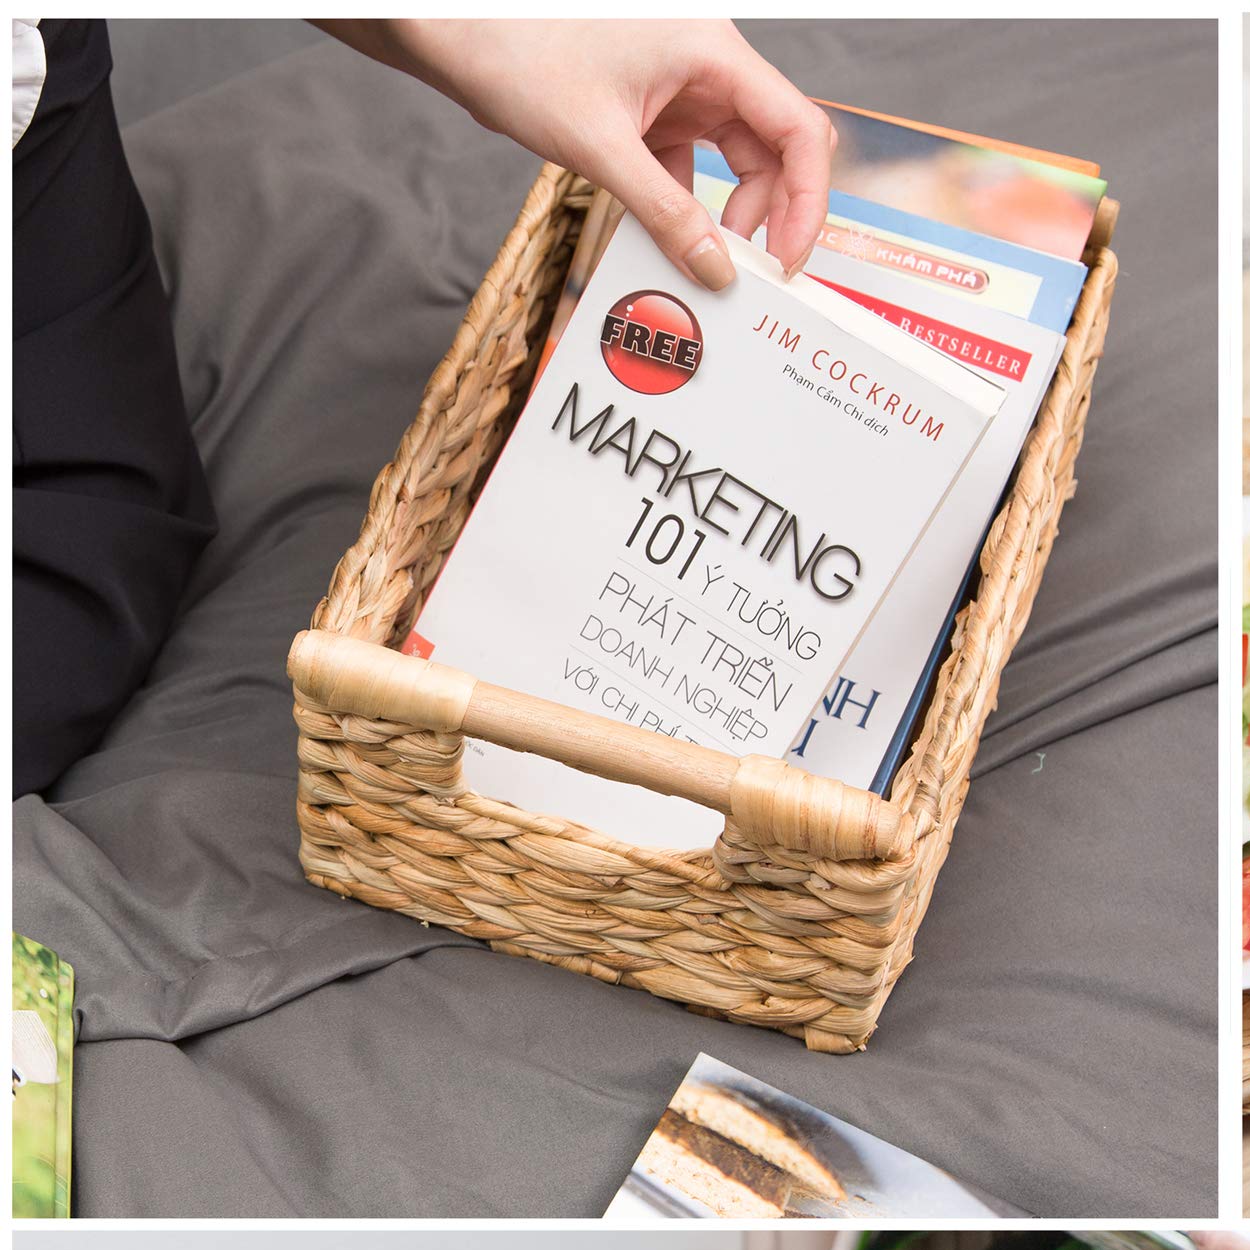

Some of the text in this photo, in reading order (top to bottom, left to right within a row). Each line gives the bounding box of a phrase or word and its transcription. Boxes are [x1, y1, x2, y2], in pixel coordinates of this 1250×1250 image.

[875, 248, 932, 273] KHÁM
[600, 314, 701, 370] FREE
[753, 315, 945, 442] JIM COCKRUM
[900, 316, 1022, 376] BESTSELLER
[783, 364, 815, 391] Phạm
[844, 403, 864, 421] Chi
[864, 418, 889, 436] dịch
[551, 382, 861, 601] MARKETING
[599, 571, 696, 646] PHÁT
[625, 497, 821, 660] 101 Ý TƯỞNG
[563, 658, 600, 695] VỚI
[601, 686, 640, 722] CHI
[580, 614, 768, 742] DOANH NGHIỆP
